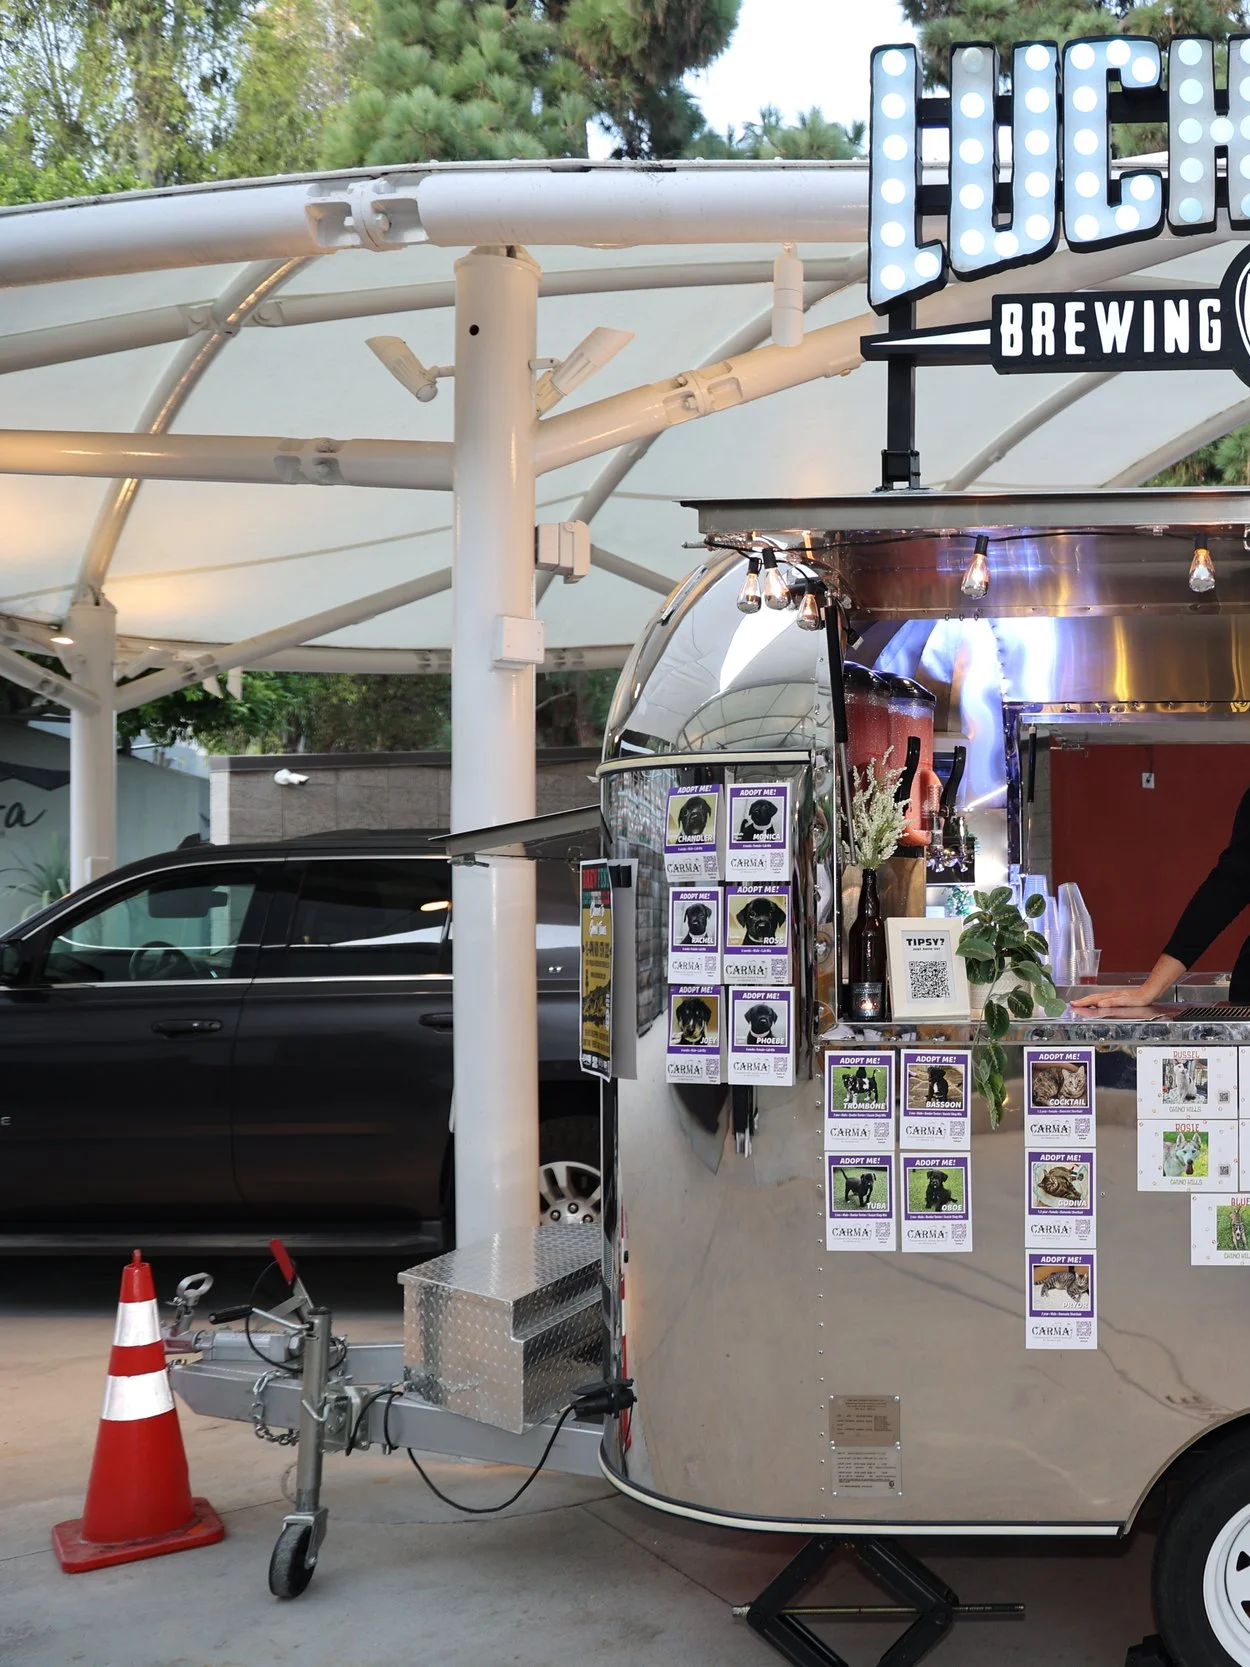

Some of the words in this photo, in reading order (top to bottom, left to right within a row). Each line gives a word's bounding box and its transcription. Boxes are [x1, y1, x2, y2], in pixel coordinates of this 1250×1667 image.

[1000, 297, 1222, 358] BREWING
[677, 785, 698, 794] ADOPT
[699, 784, 712, 793] ME!
[763, 788, 777, 796] ME!
[678, 834, 713, 843] CHANDLER
[752, 833, 780, 841] MONICA
[737, 885, 761, 893] ADOPT
[763, 885, 779, 893] ME!
[680, 892, 698, 900] ADOPT
[699, 892, 710, 900] ME!
[763, 936, 784, 944] ROSS
[906, 938, 945, 946] TIPSY?
[678, 986, 700, 994] ADOPT
[766, 991, 780, 999] ME!
[700, 1036, 717, 1045] JOEY
[756, 1037, 785, 1045] PHOEBE
[1173, 1050, 1200, 1059] RUSSEL
[843, 1102, 886, 1110] TROMBONE
[1049, 1098, 1086, 1106] COCKTAIL
[1175, 1123, 1200, 1132] ROSIE
[866, 1202, 887, 1210] TUBA
[1057, 1199, 1087, 1207] GODIVA
